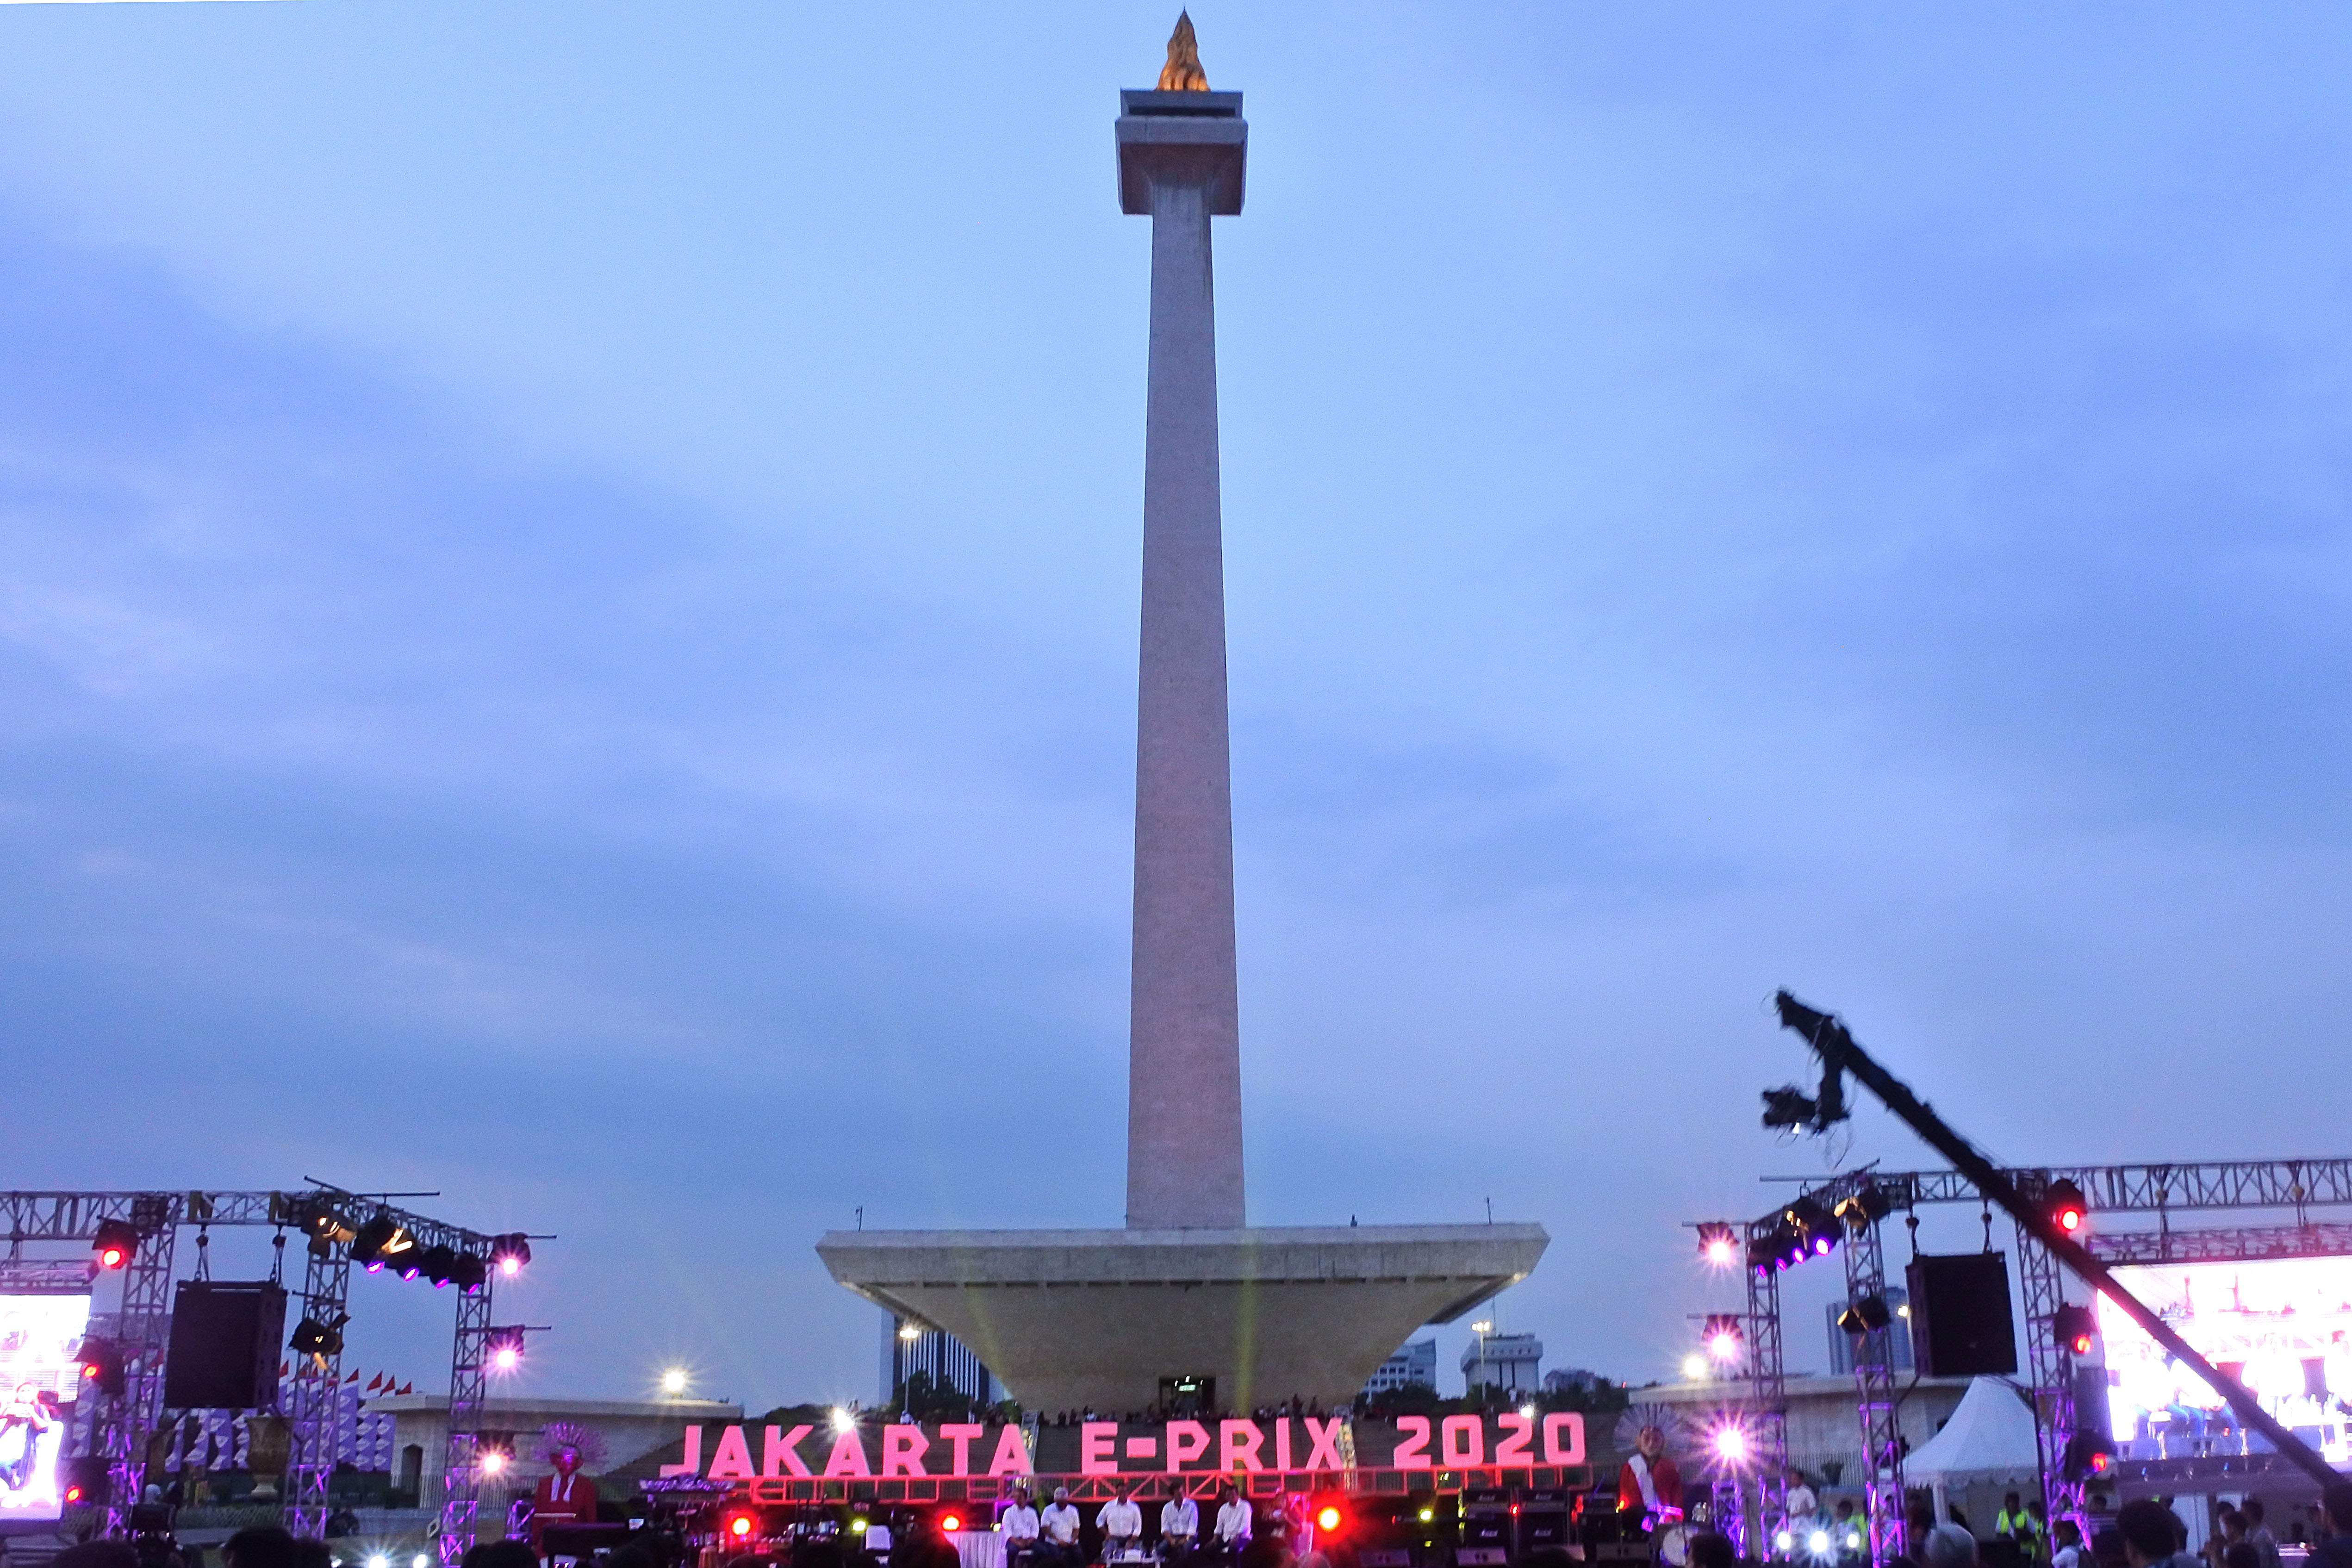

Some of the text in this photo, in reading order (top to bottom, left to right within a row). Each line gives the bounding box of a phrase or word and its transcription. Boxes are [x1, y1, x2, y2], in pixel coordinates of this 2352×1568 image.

[660, 1412, 1586, 1478] JAKARTA E-PRIX 2020
